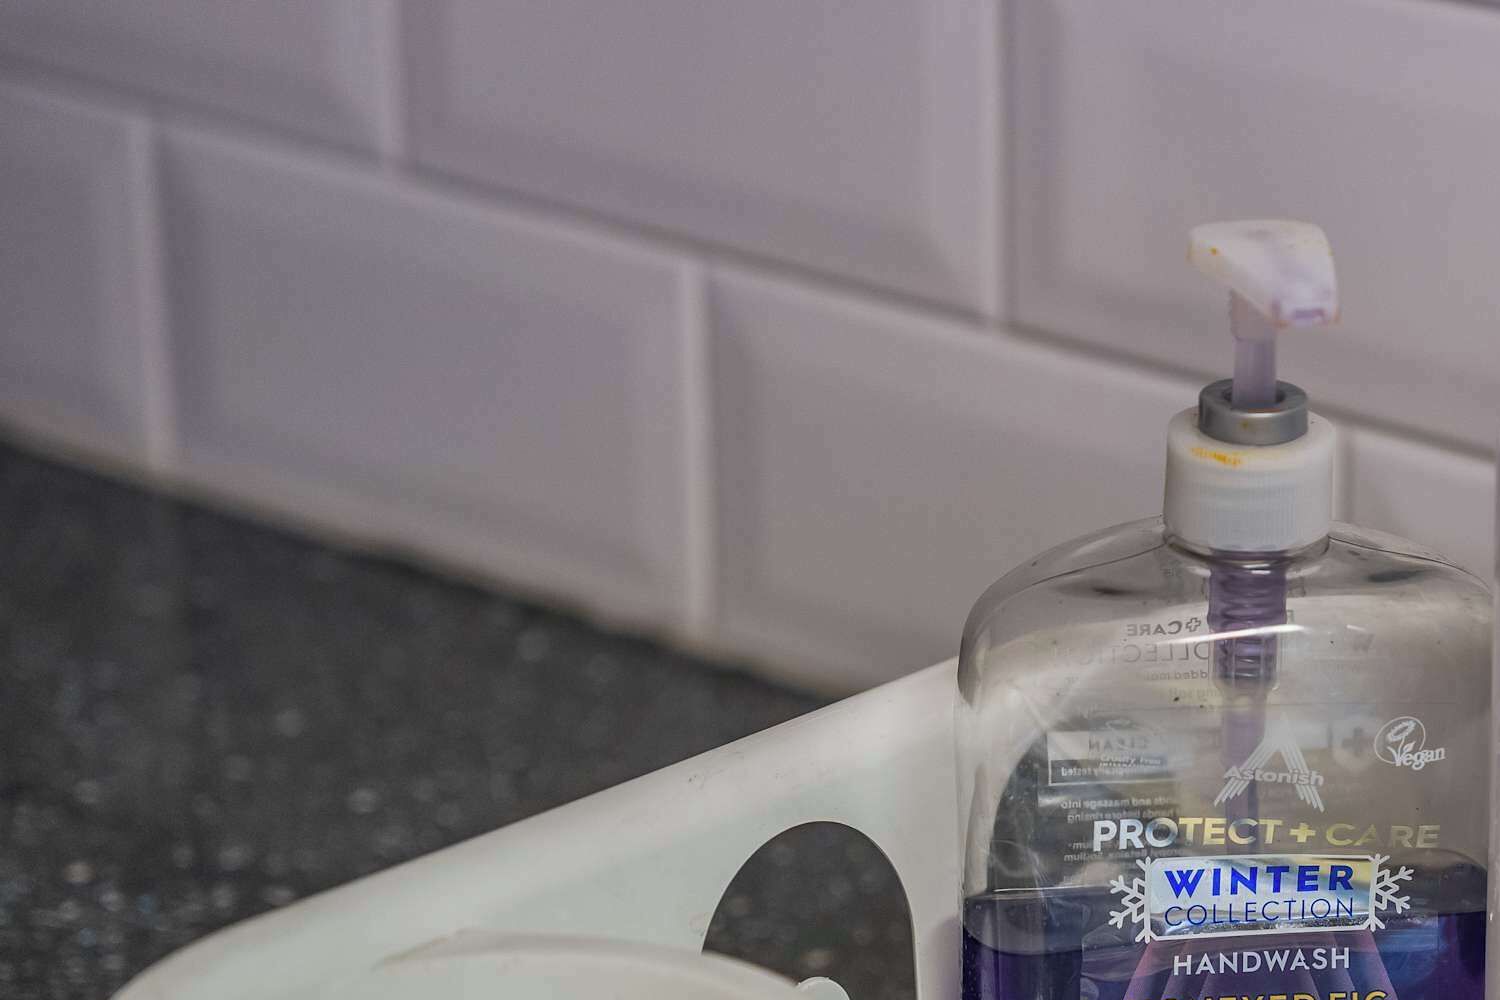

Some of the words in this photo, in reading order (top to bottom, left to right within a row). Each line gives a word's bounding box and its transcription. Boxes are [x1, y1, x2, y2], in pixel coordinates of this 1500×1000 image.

[1387, 746, 1446, 771] Vegan
[1223, 765, 1325, 787] Astonish
[1093, 817, 1283, 852] PROTECT
[1325, 823, 1441, 849] CARE
[1164, 864, 1354, 899] WINTER
[1164, 896, 1354, 927] COLLECTION
[1173, 946, 1350, 976] HANDWASH
